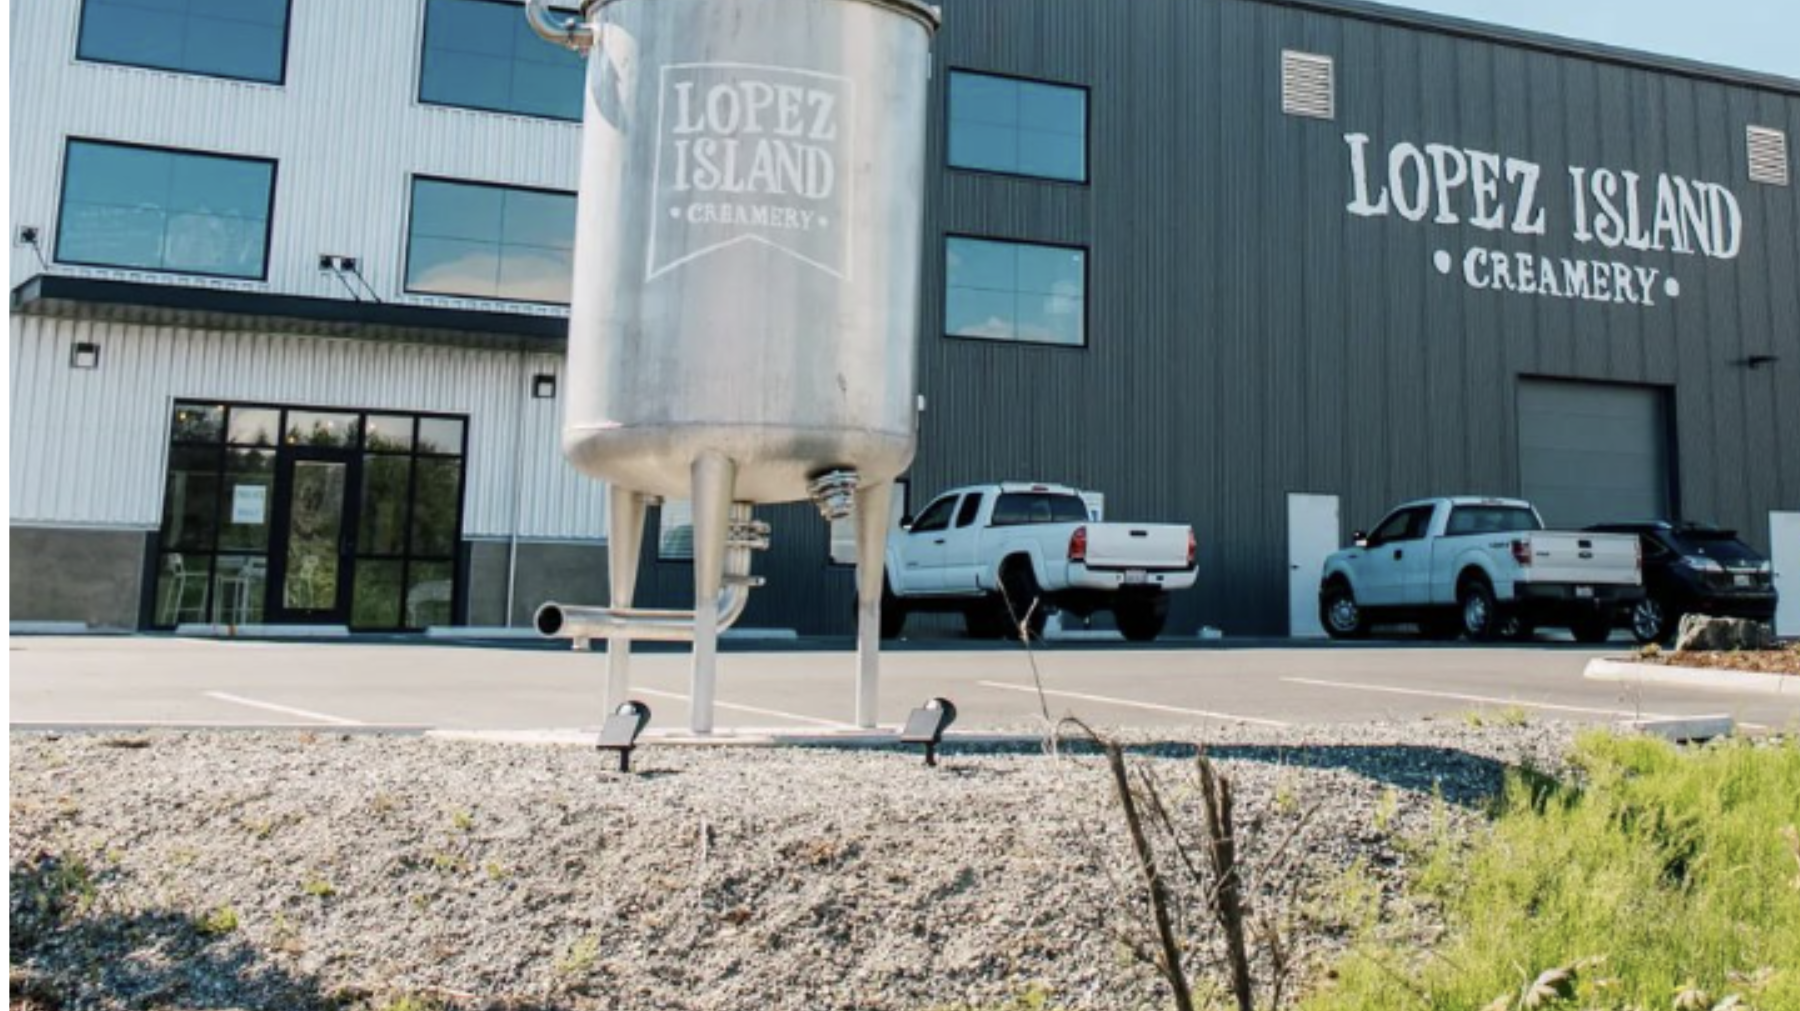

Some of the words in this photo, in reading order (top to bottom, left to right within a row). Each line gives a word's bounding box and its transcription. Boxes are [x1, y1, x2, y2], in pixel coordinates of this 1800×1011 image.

[673, 81, 837, 140] LOPEZ
[673, 138, 835, 200] ISLAND
[1343, 132, 1547, 236] LOPEZ
[1568, 166, 1743, 260] ISLAND
[686, 203, 815, 230] CREAMERY
[1462, 246, 1660, 307] CREAMERY
